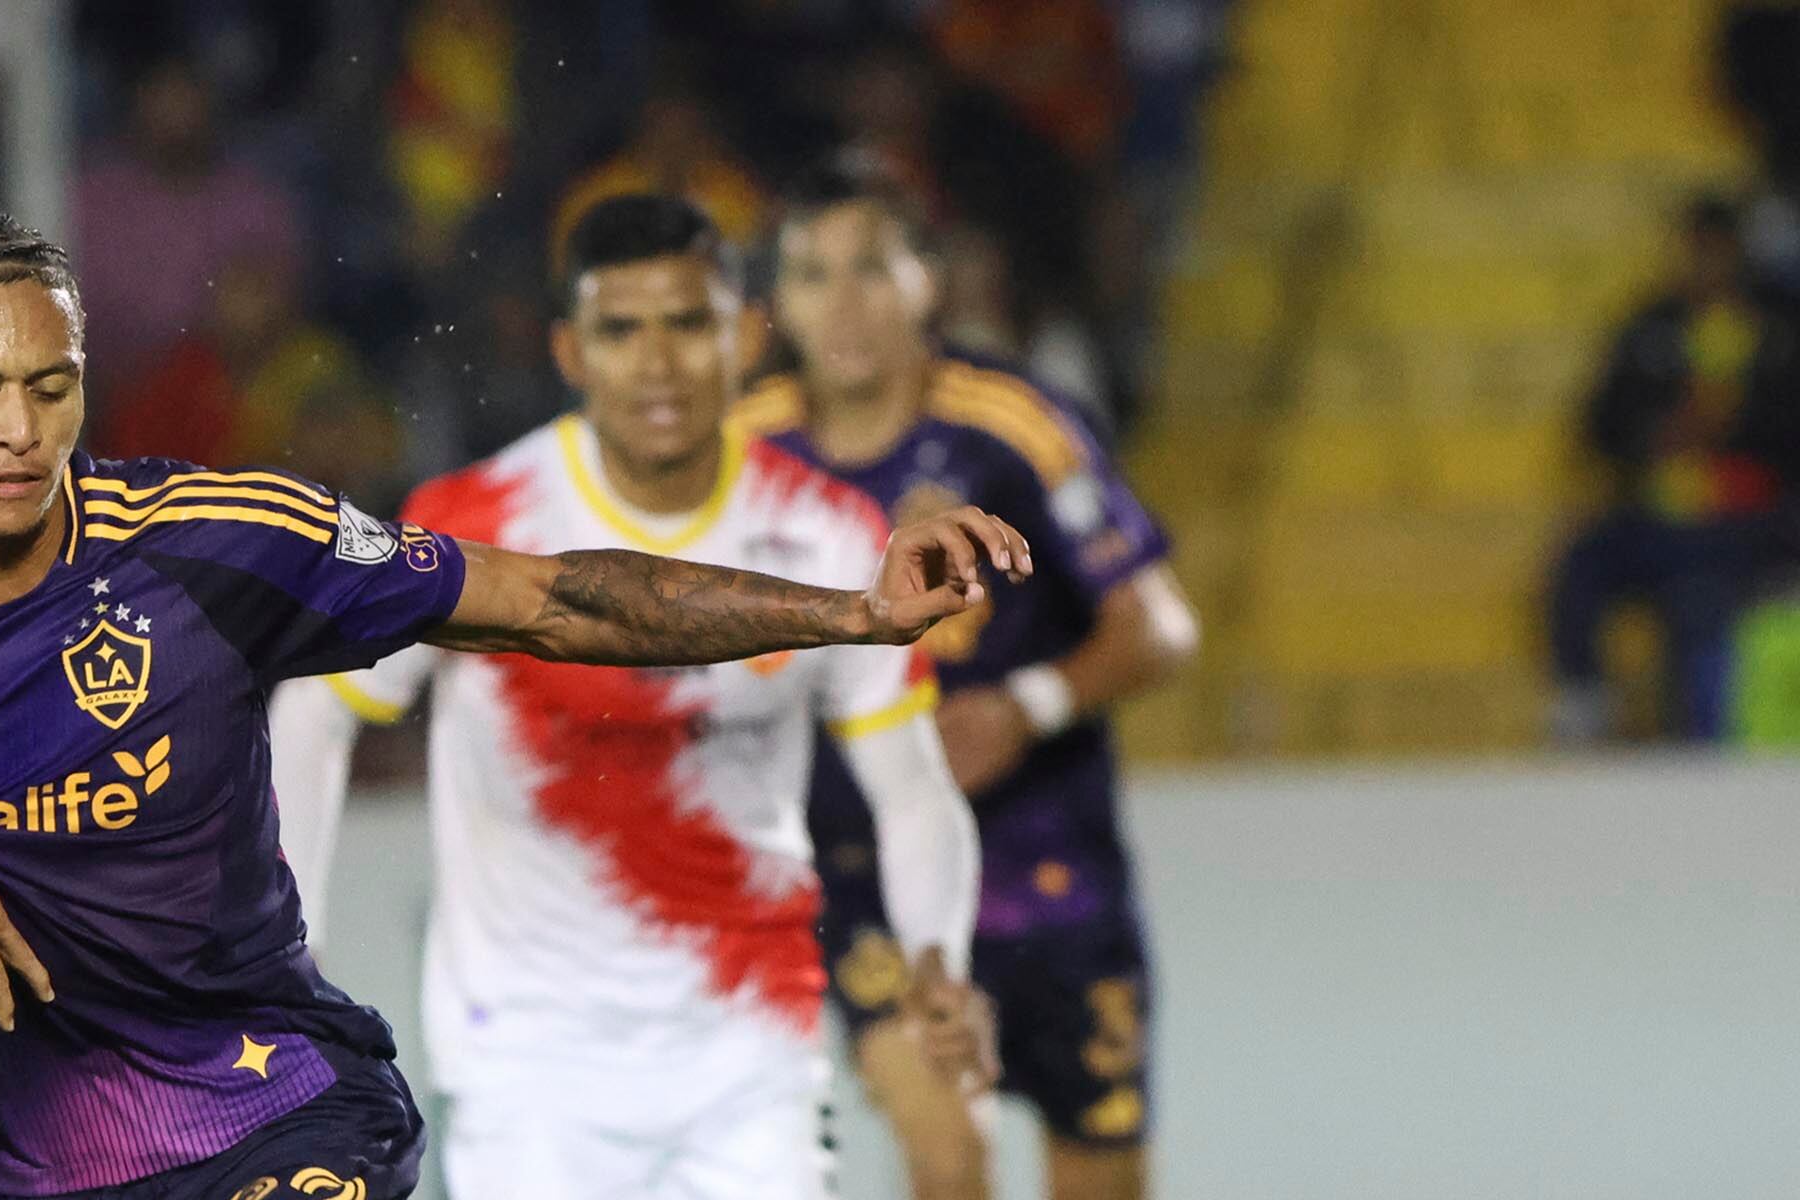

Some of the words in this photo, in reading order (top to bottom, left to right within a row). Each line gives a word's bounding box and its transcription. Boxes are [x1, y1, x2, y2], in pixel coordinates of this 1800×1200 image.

[343, 524, 356, 553] MLS
[84, 658, 135, 689] LA
[86, 692, 138, 704] GALAXY
